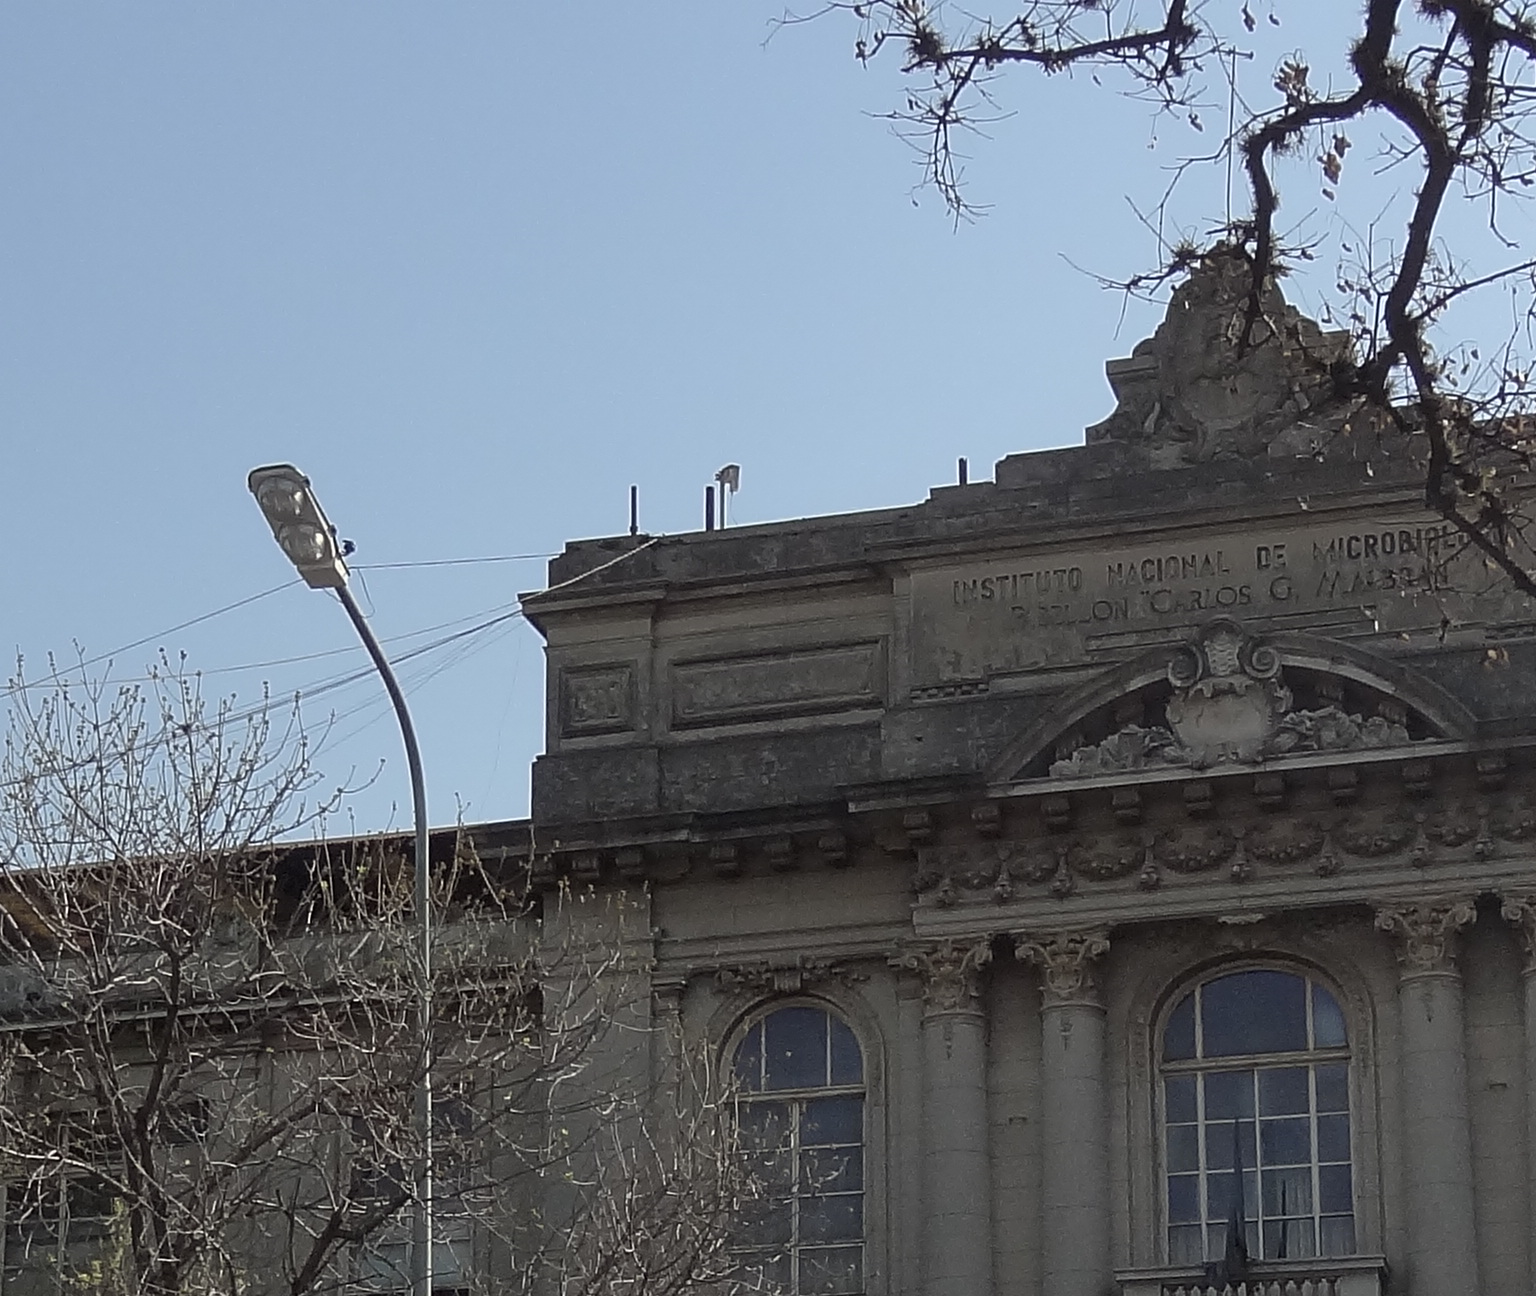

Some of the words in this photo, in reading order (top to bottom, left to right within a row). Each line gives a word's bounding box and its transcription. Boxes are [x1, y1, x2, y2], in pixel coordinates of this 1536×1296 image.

[952, 566, 1084, 604] INSTITUTO
[1106, 549, 1231, 588] NACIONAL
[1255, 542, 1288, 571] DE
